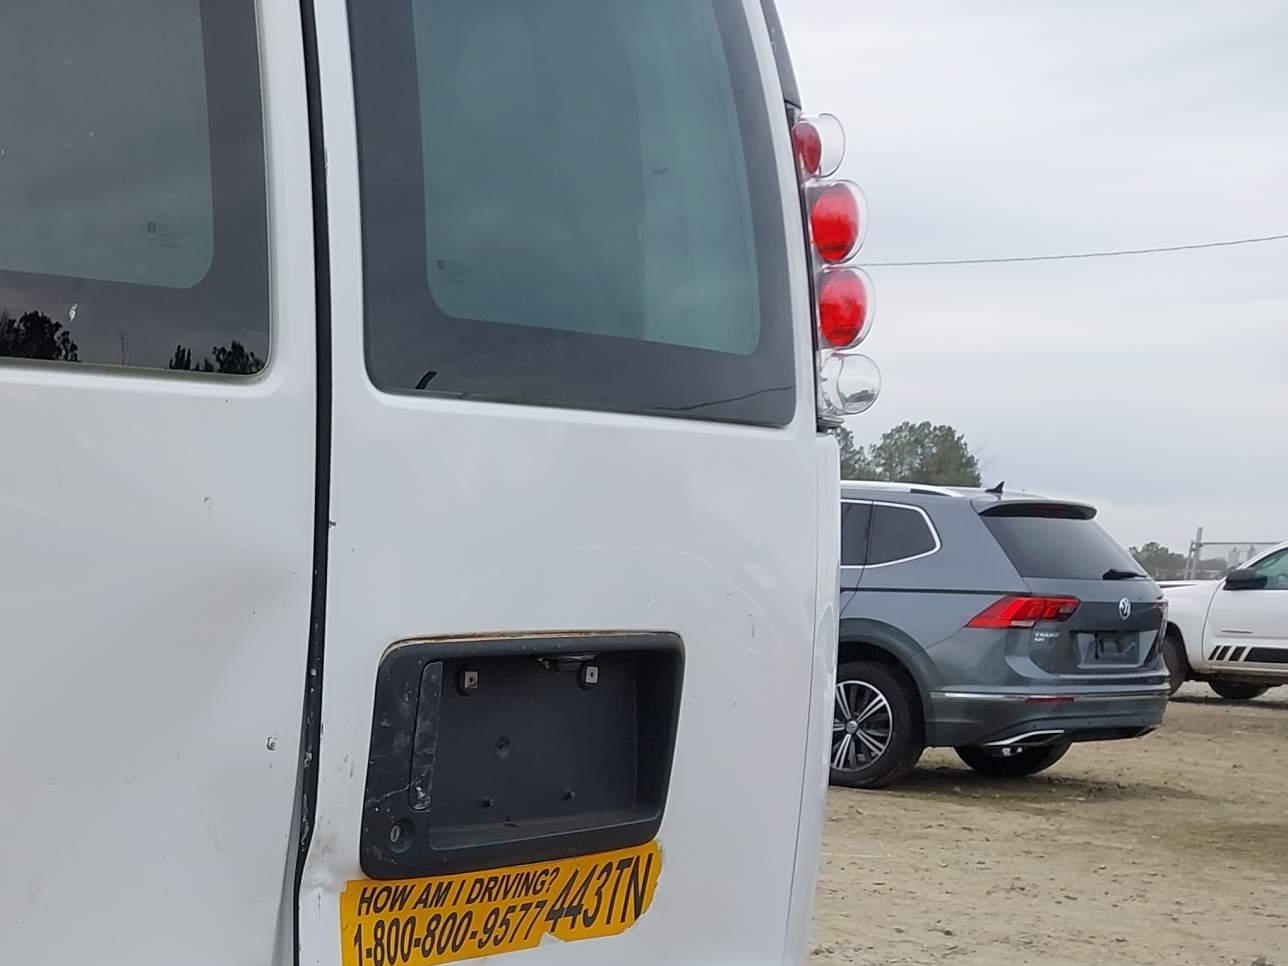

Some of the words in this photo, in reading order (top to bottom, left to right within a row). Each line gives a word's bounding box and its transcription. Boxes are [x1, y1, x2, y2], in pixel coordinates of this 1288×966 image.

[357, 885, 415, 917] HOW
[413, 879, 453, 910] AM
[453, 879, 464, 906] I
[465, 866, 560, 905] DRIVING?
[545, 853, 653, 933] 443TN
